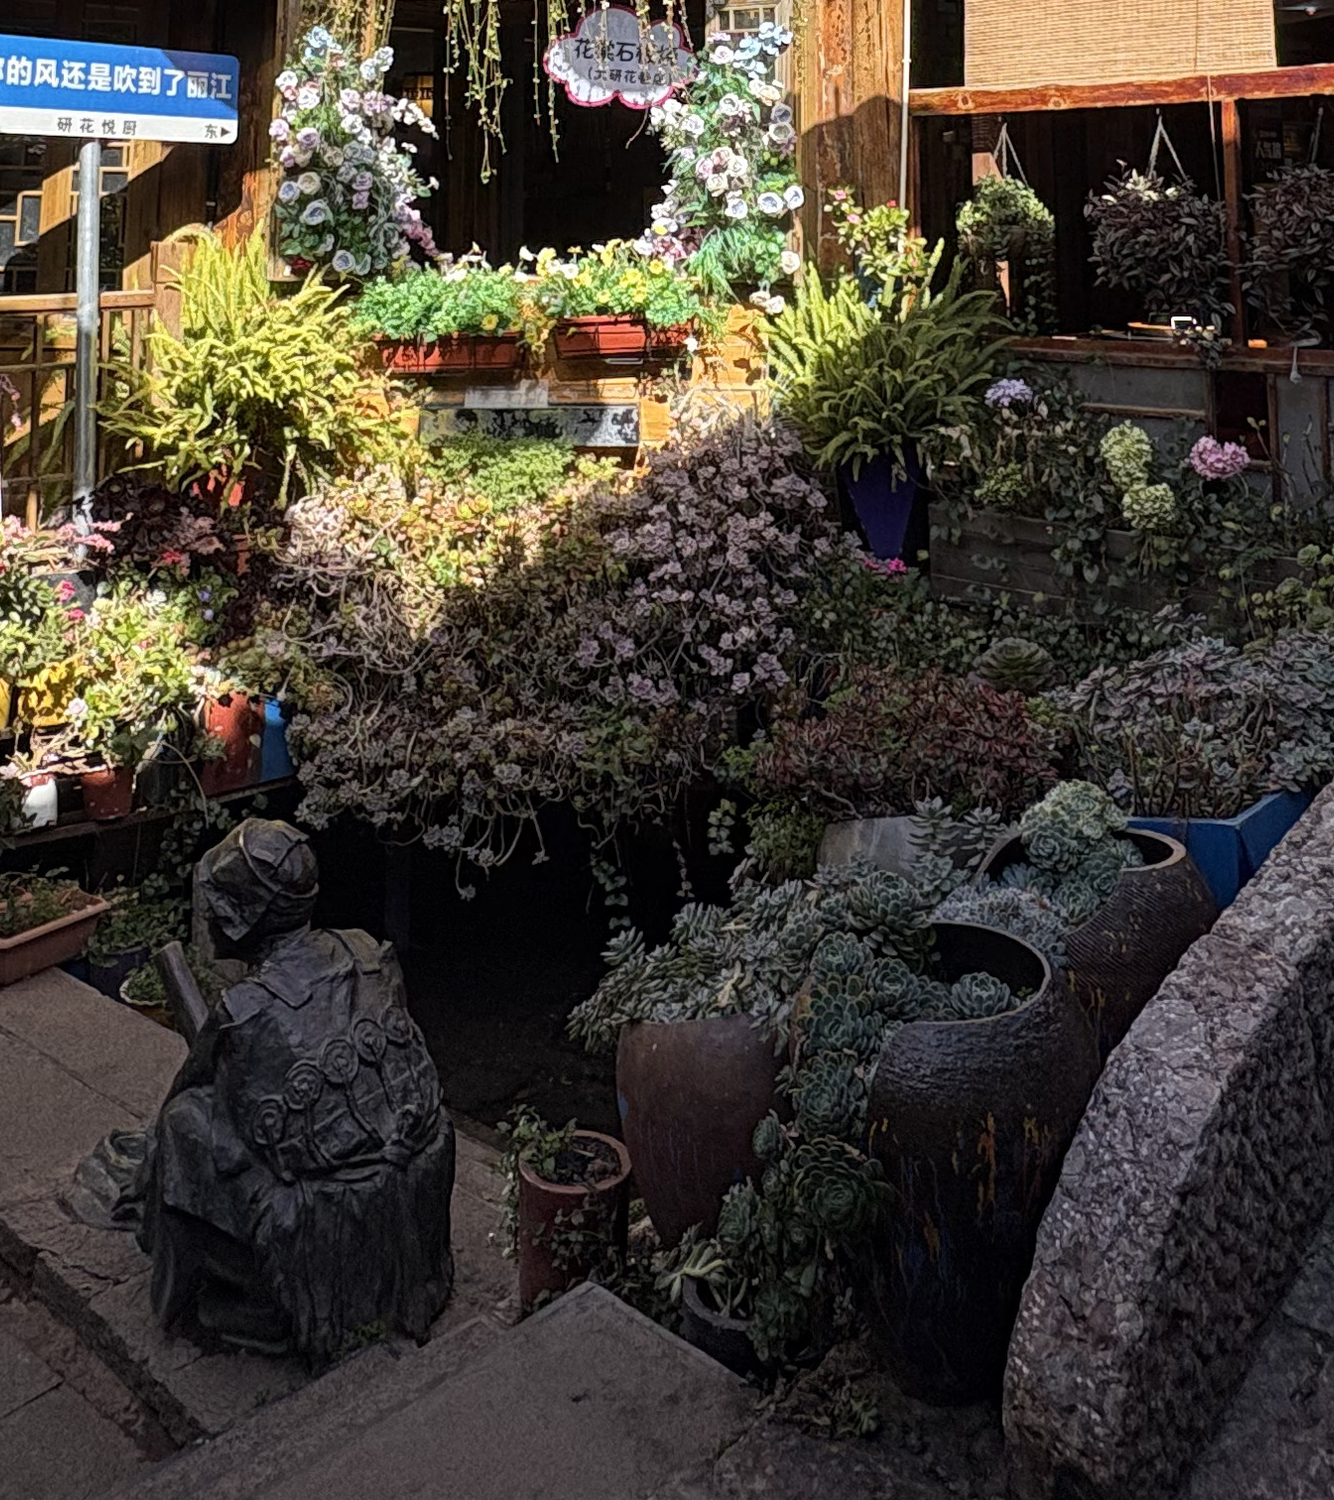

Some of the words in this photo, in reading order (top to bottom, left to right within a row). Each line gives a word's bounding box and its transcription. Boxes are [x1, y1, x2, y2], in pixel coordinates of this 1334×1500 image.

[57, 117, 137, 136] 研花悦厨
[204, 124, 218, 139] 东
